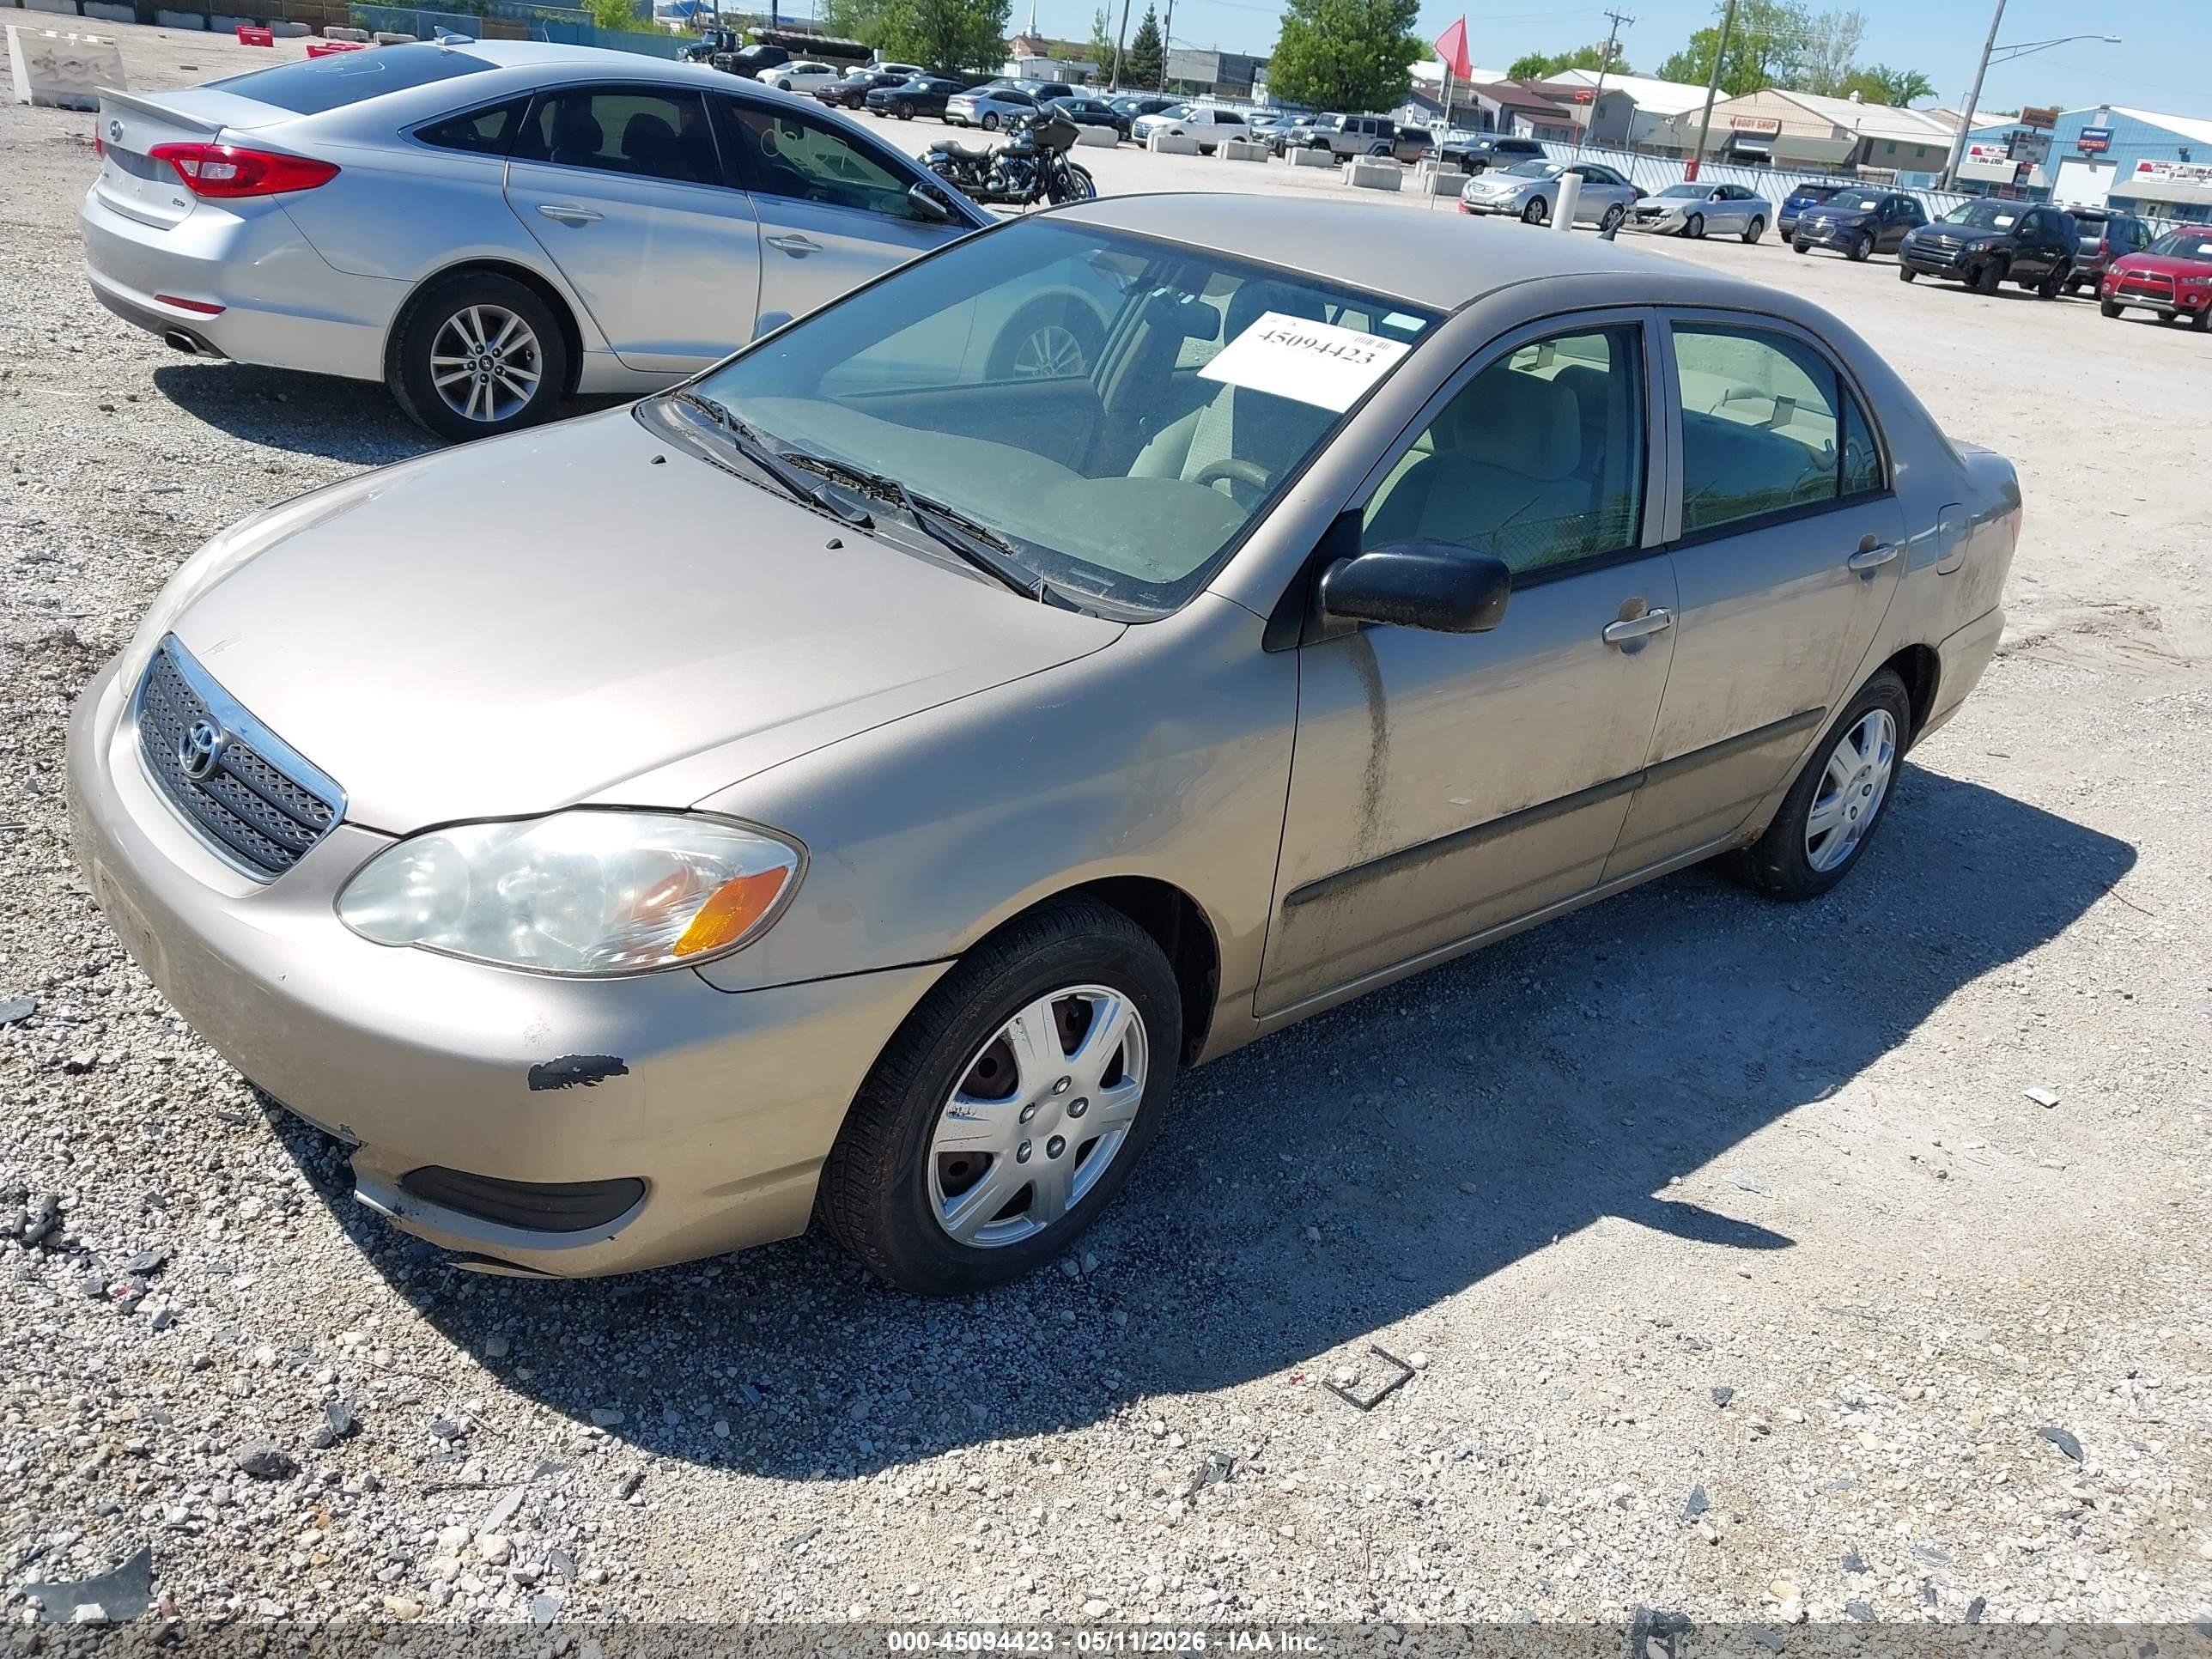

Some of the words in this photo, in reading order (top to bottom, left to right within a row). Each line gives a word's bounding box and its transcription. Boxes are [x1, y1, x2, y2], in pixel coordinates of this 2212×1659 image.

[1736, 118, 1754, 129] BODY
[1757, 120, 1777, 131] SHOP
[1259, 330, 1376, 365] 45094423
